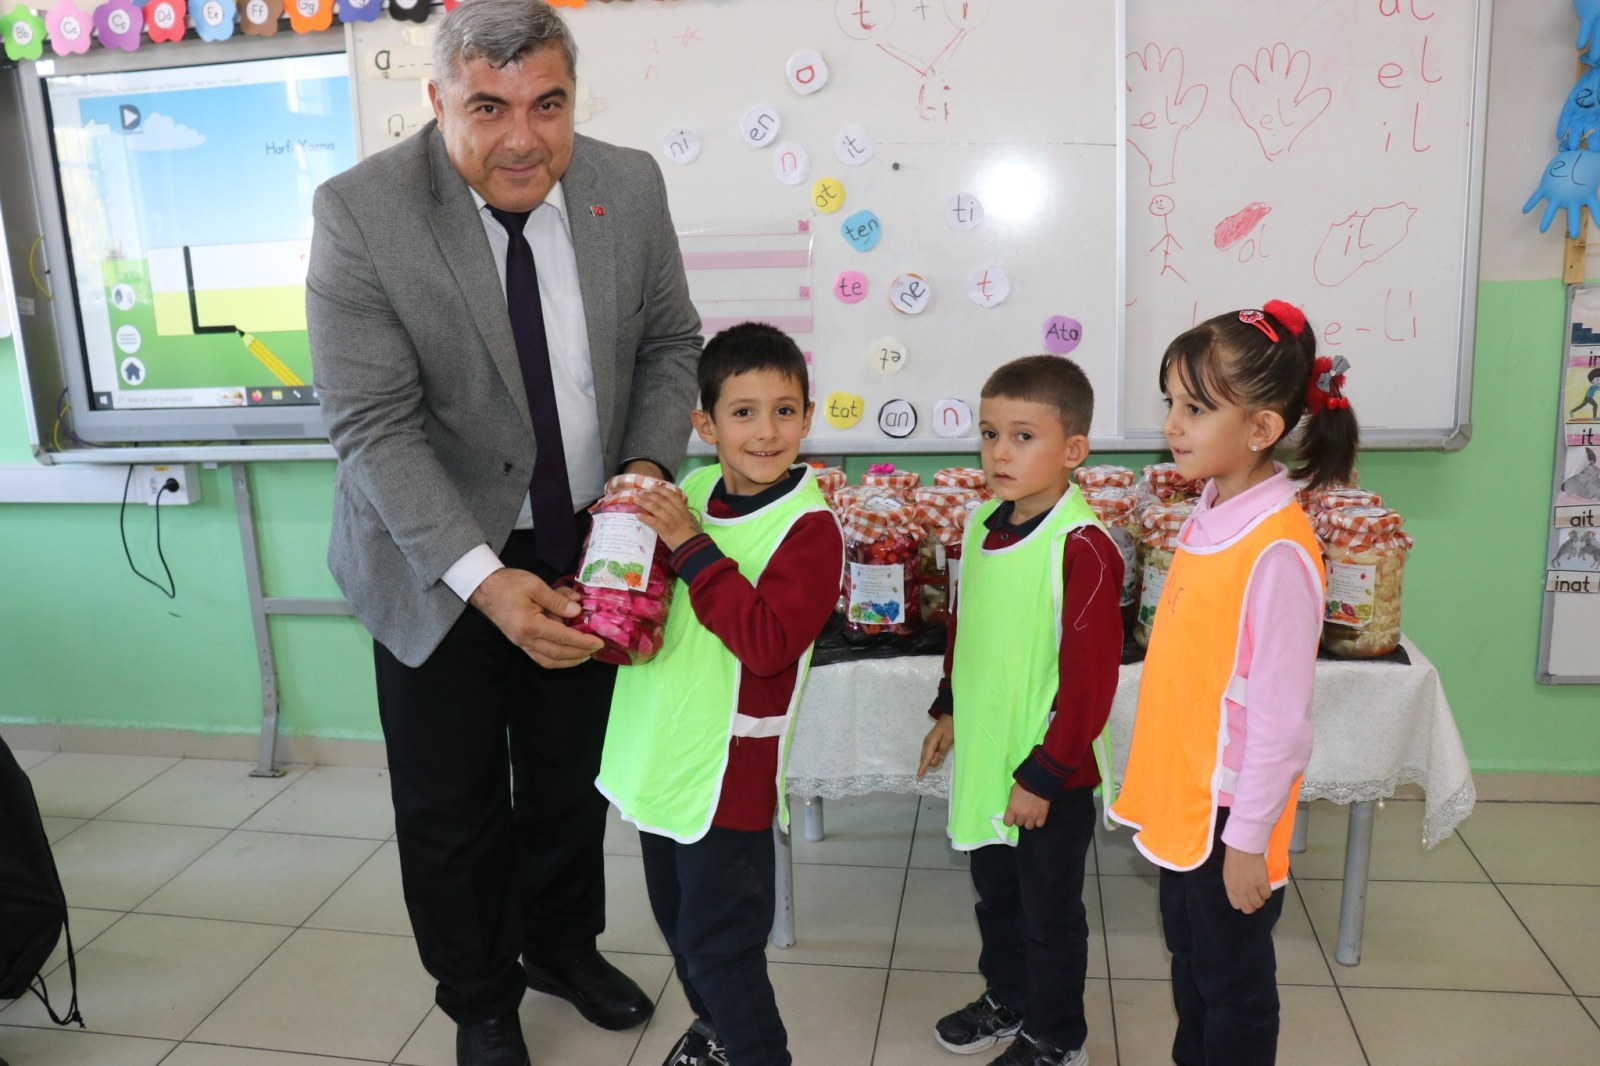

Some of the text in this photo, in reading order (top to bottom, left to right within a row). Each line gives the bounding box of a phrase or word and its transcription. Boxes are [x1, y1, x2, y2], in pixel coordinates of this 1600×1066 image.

[157, 9, 172, 23] Dd
[207, 7, 219, 20] Ee
[251, 4, 264, 17] Ff
[63, 21, 78, 34] Cc
[1378, 36, 1442, 89] el
[1575, 79, 1600, 109] e
[1259, 97, 1295, 130] el
[749, 113, 775, 141] en
[265, 139, 294, 155] Harfi
[669, 131, 689, 158] ni
[842, 134, 866, 160] it
[1549, 153, 1586, 186] el
[952, 194, 974, 223] ti
[845, 217, 879, 243] ten
[838, 276, 863, 298] te
[900, 281, 926, 308] ne
[885, 410, 909, 428] an
[1581, 428, 1594, 445] it
[1569, 509, 1594, 527] ait
[1554, 575, 1590, 592] inat
